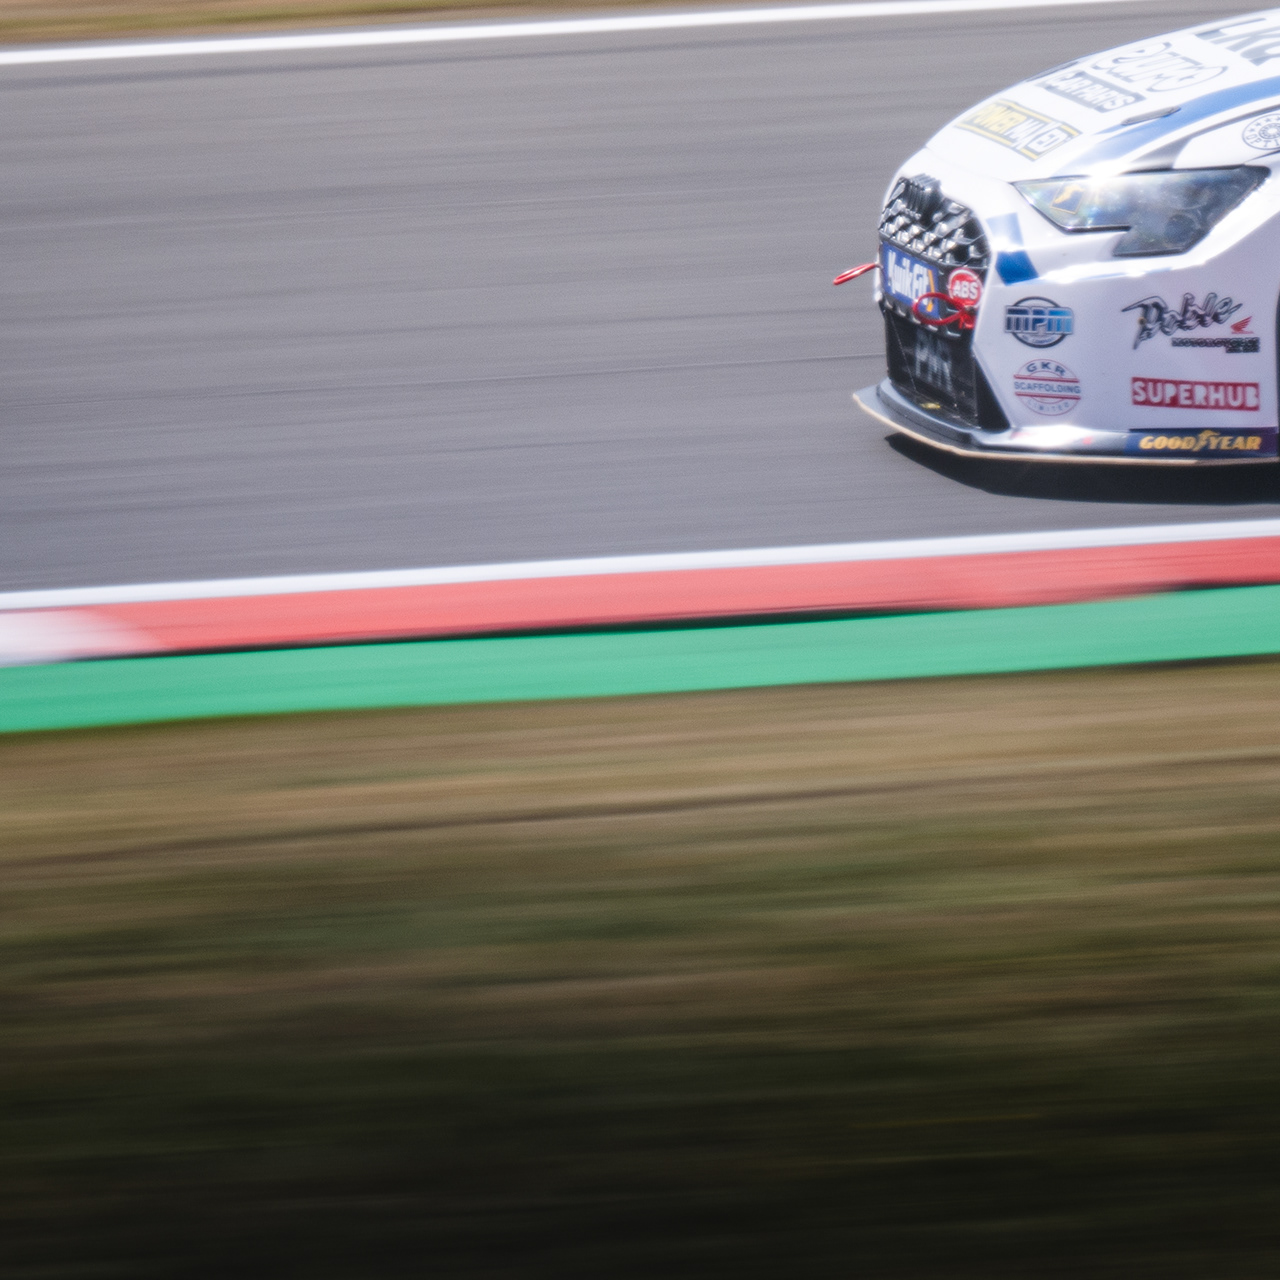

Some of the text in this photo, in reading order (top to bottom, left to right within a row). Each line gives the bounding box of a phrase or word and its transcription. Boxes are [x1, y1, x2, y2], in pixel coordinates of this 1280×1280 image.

[952, 280, 979, 300] ABS
[1026, 361, 1066, 377] GKR
[1014, 381, 1081, 394] SCAFFOLDING
[1133, 380, 1260, 408] SUPERHUB
[1139, 432, 1263, 451] GOODYEAR
